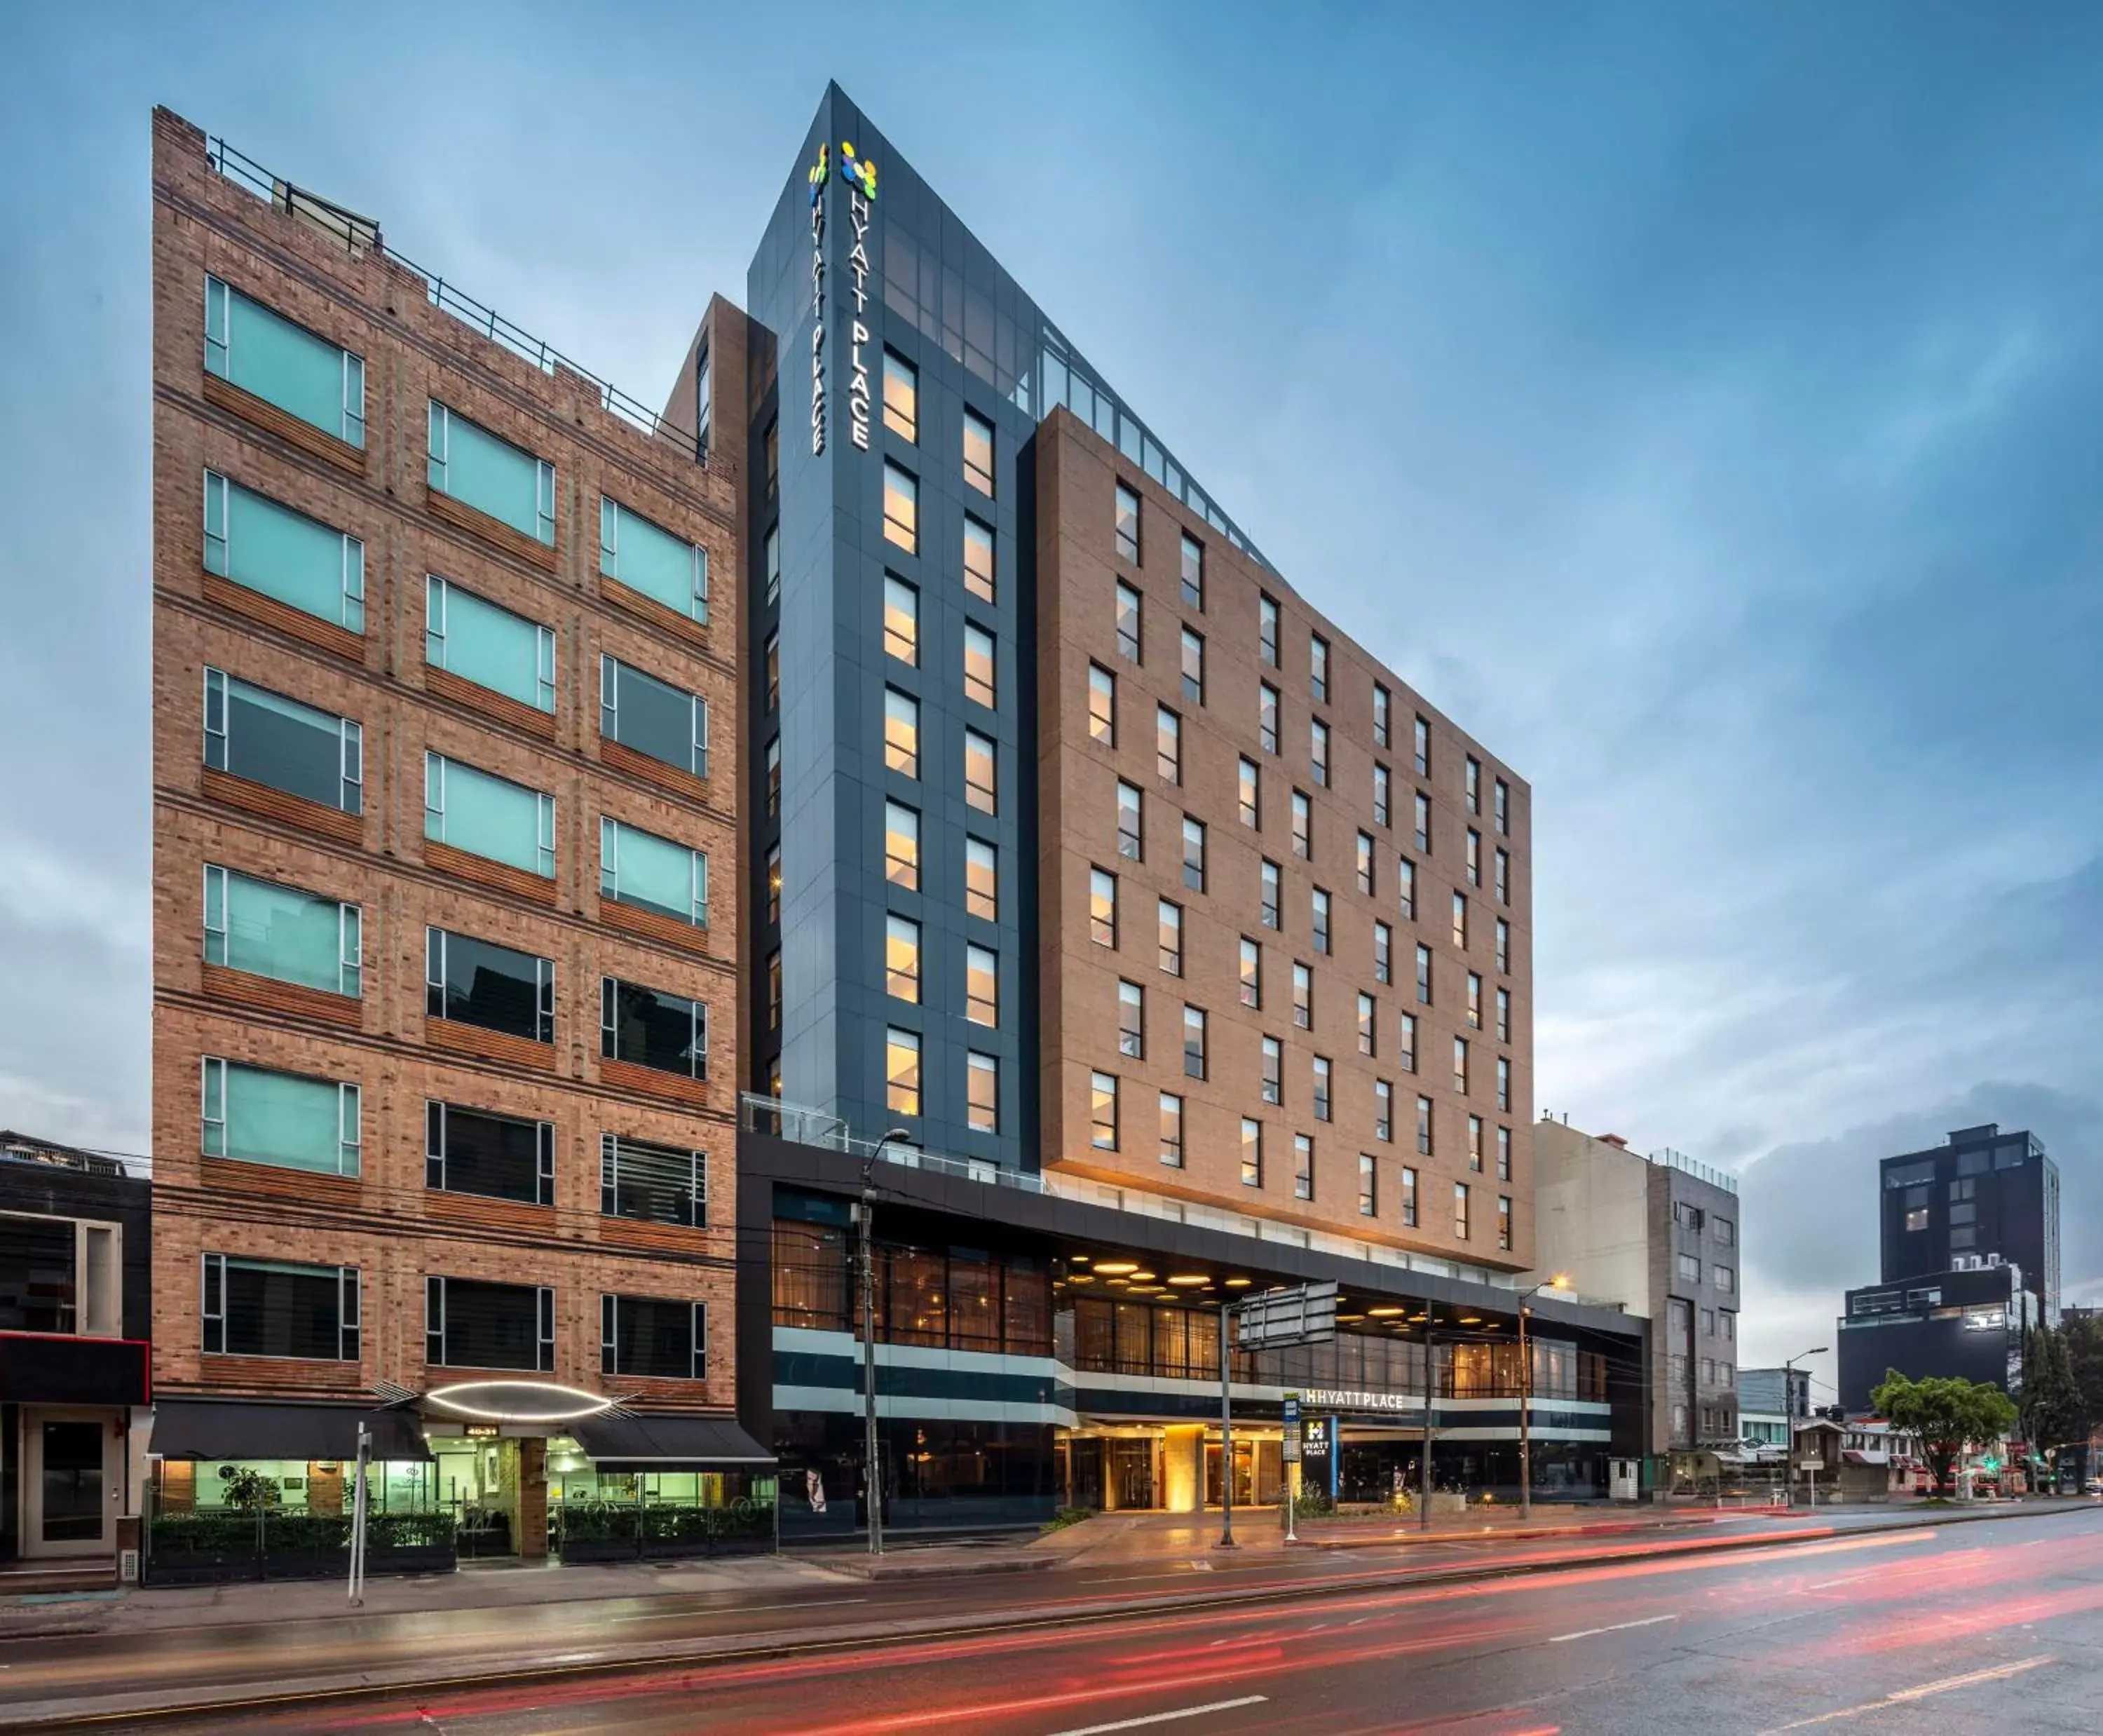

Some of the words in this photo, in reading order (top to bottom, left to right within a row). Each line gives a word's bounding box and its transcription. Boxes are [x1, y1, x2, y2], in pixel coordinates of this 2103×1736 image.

[812, 194, 823, 317] HYATT
[850, 190, 869, 313] HYATT
[812, 325, 824, 455] PLACE
[850, 320, 870, 449] PLACE
[1303, 1441, 1329, 1449] HYATT
[1363, 1393, 1403, 1409] PLACE
